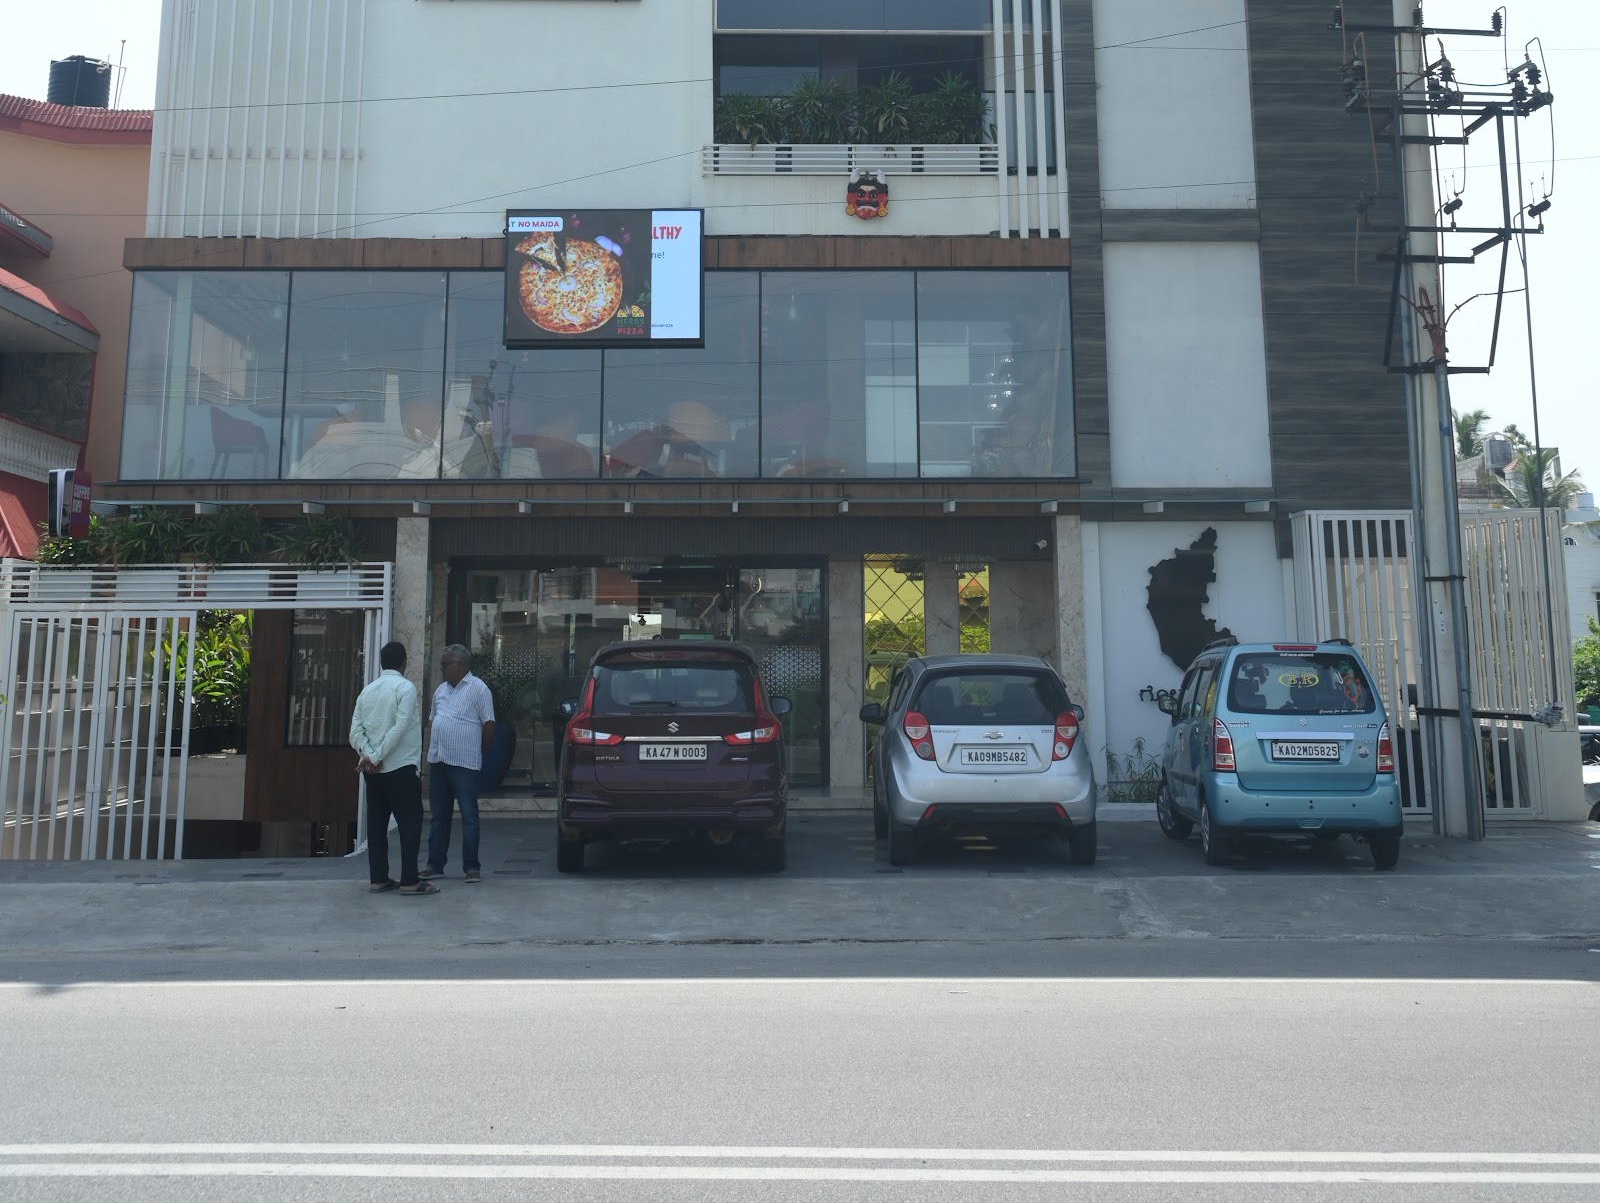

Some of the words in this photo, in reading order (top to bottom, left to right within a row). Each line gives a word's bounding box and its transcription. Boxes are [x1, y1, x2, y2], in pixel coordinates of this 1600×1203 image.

[651, 226, 682, 240] LTHY
[617, 327, 644, 335] PIZZA
[646, 747, 658, 758] KA
[659, 747, 671, 758] 47
[682, 747, 706, 758] 0003
[1278, 744, 1338, 757] KA02MD5825
[968, 751, 1026, 762] KA09MB5482
